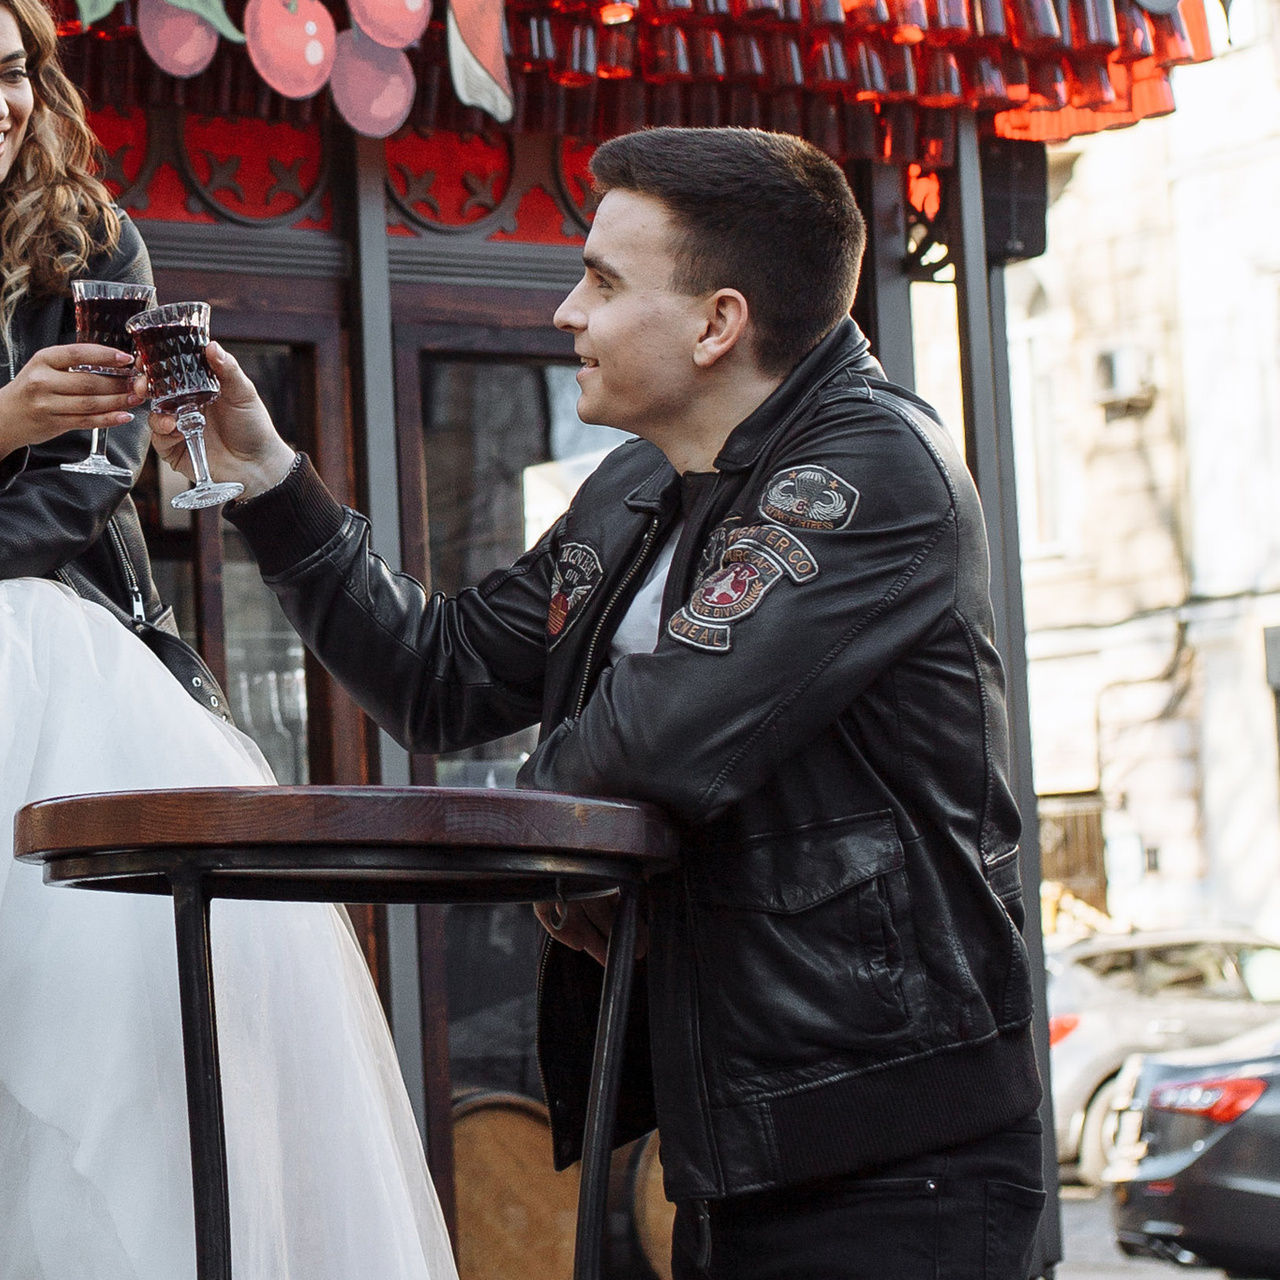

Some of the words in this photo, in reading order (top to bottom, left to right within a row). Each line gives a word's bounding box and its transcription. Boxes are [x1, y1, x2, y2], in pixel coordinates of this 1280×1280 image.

[727, 525, 790, 554] FIGHTER
[788, 549, 813, 574] CO
[713, 596, 755, 618] DIVISION
